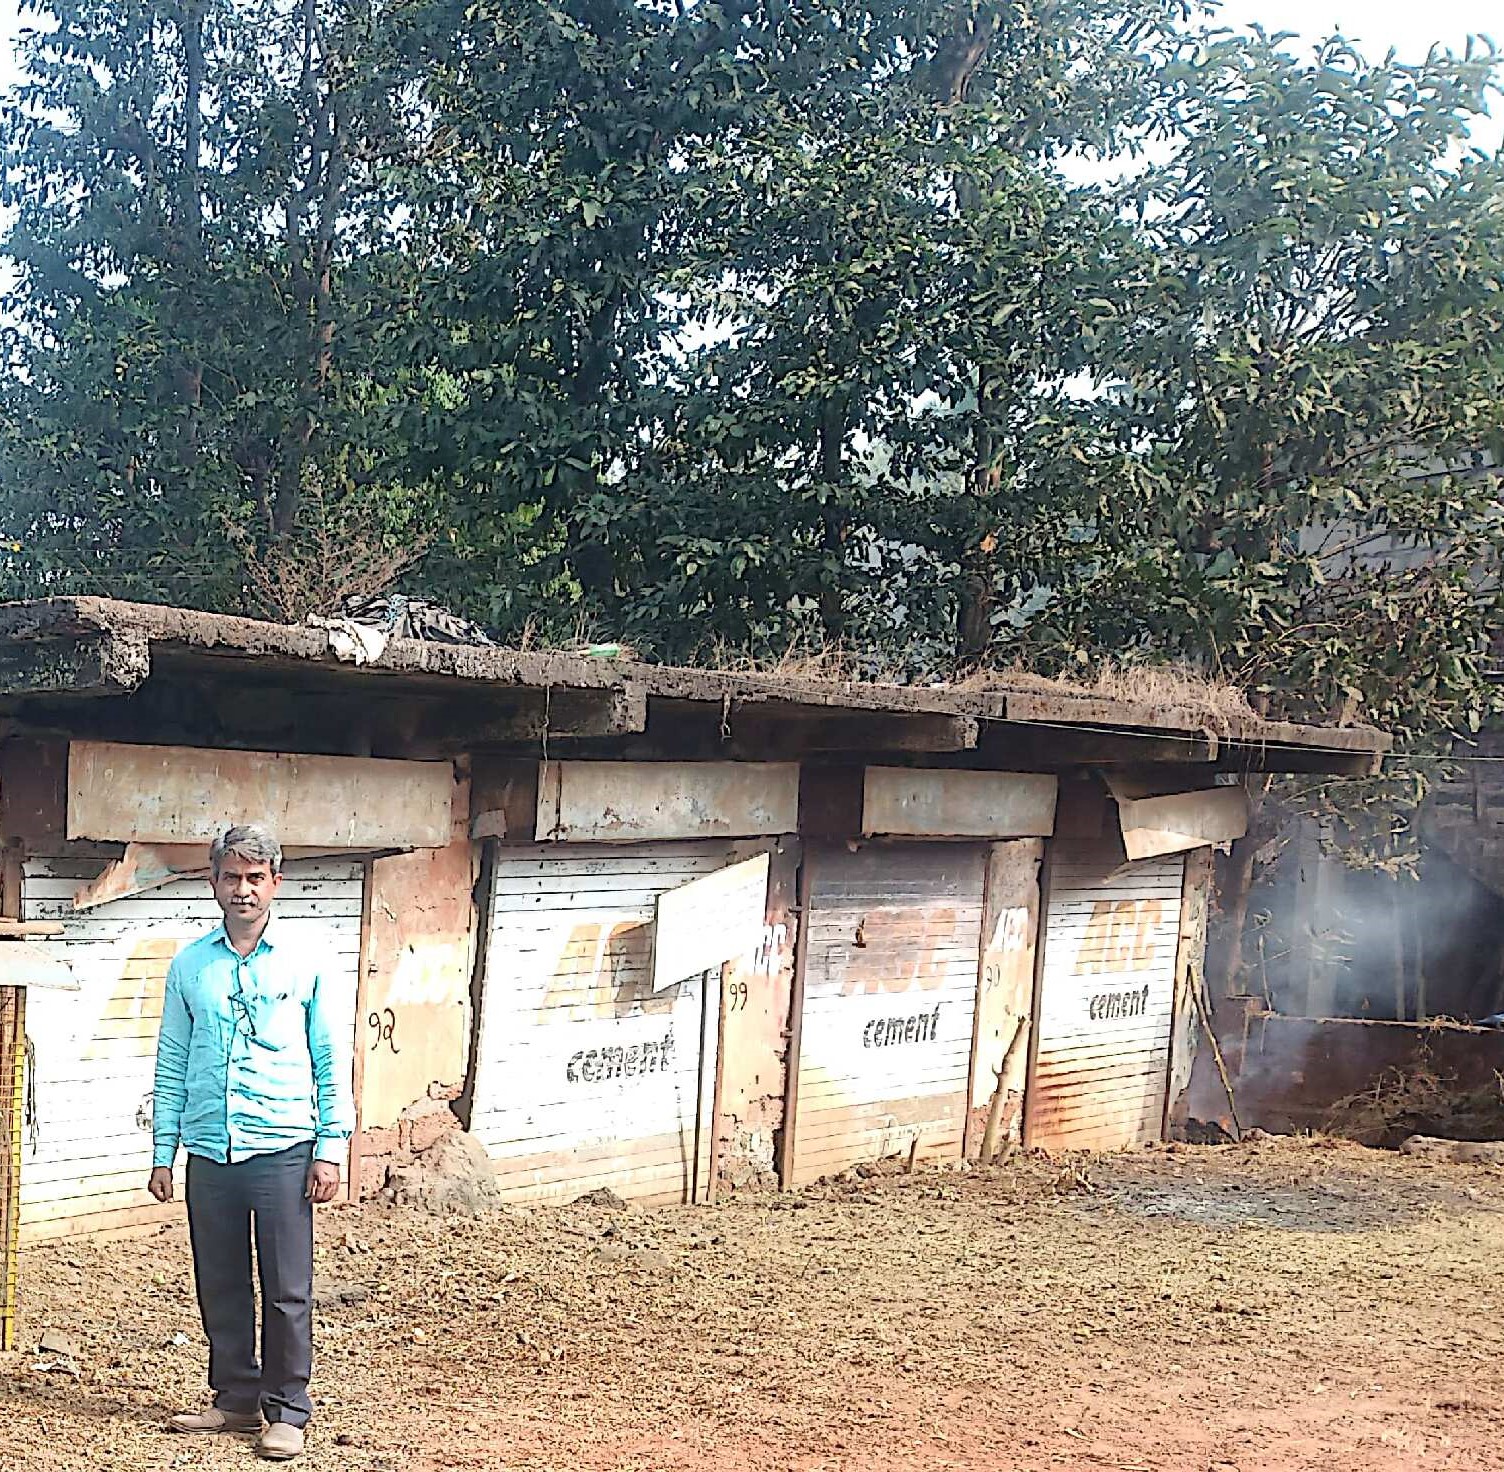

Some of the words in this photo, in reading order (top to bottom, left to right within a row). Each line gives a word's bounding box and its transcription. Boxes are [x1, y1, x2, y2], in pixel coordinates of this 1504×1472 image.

[1073, 901, 1163, 974] ACC
[863, 1001, 940, 1048] cement
[1089, 983, 1149, 1021] cement
[566, 1030, 676, 1083] cement
